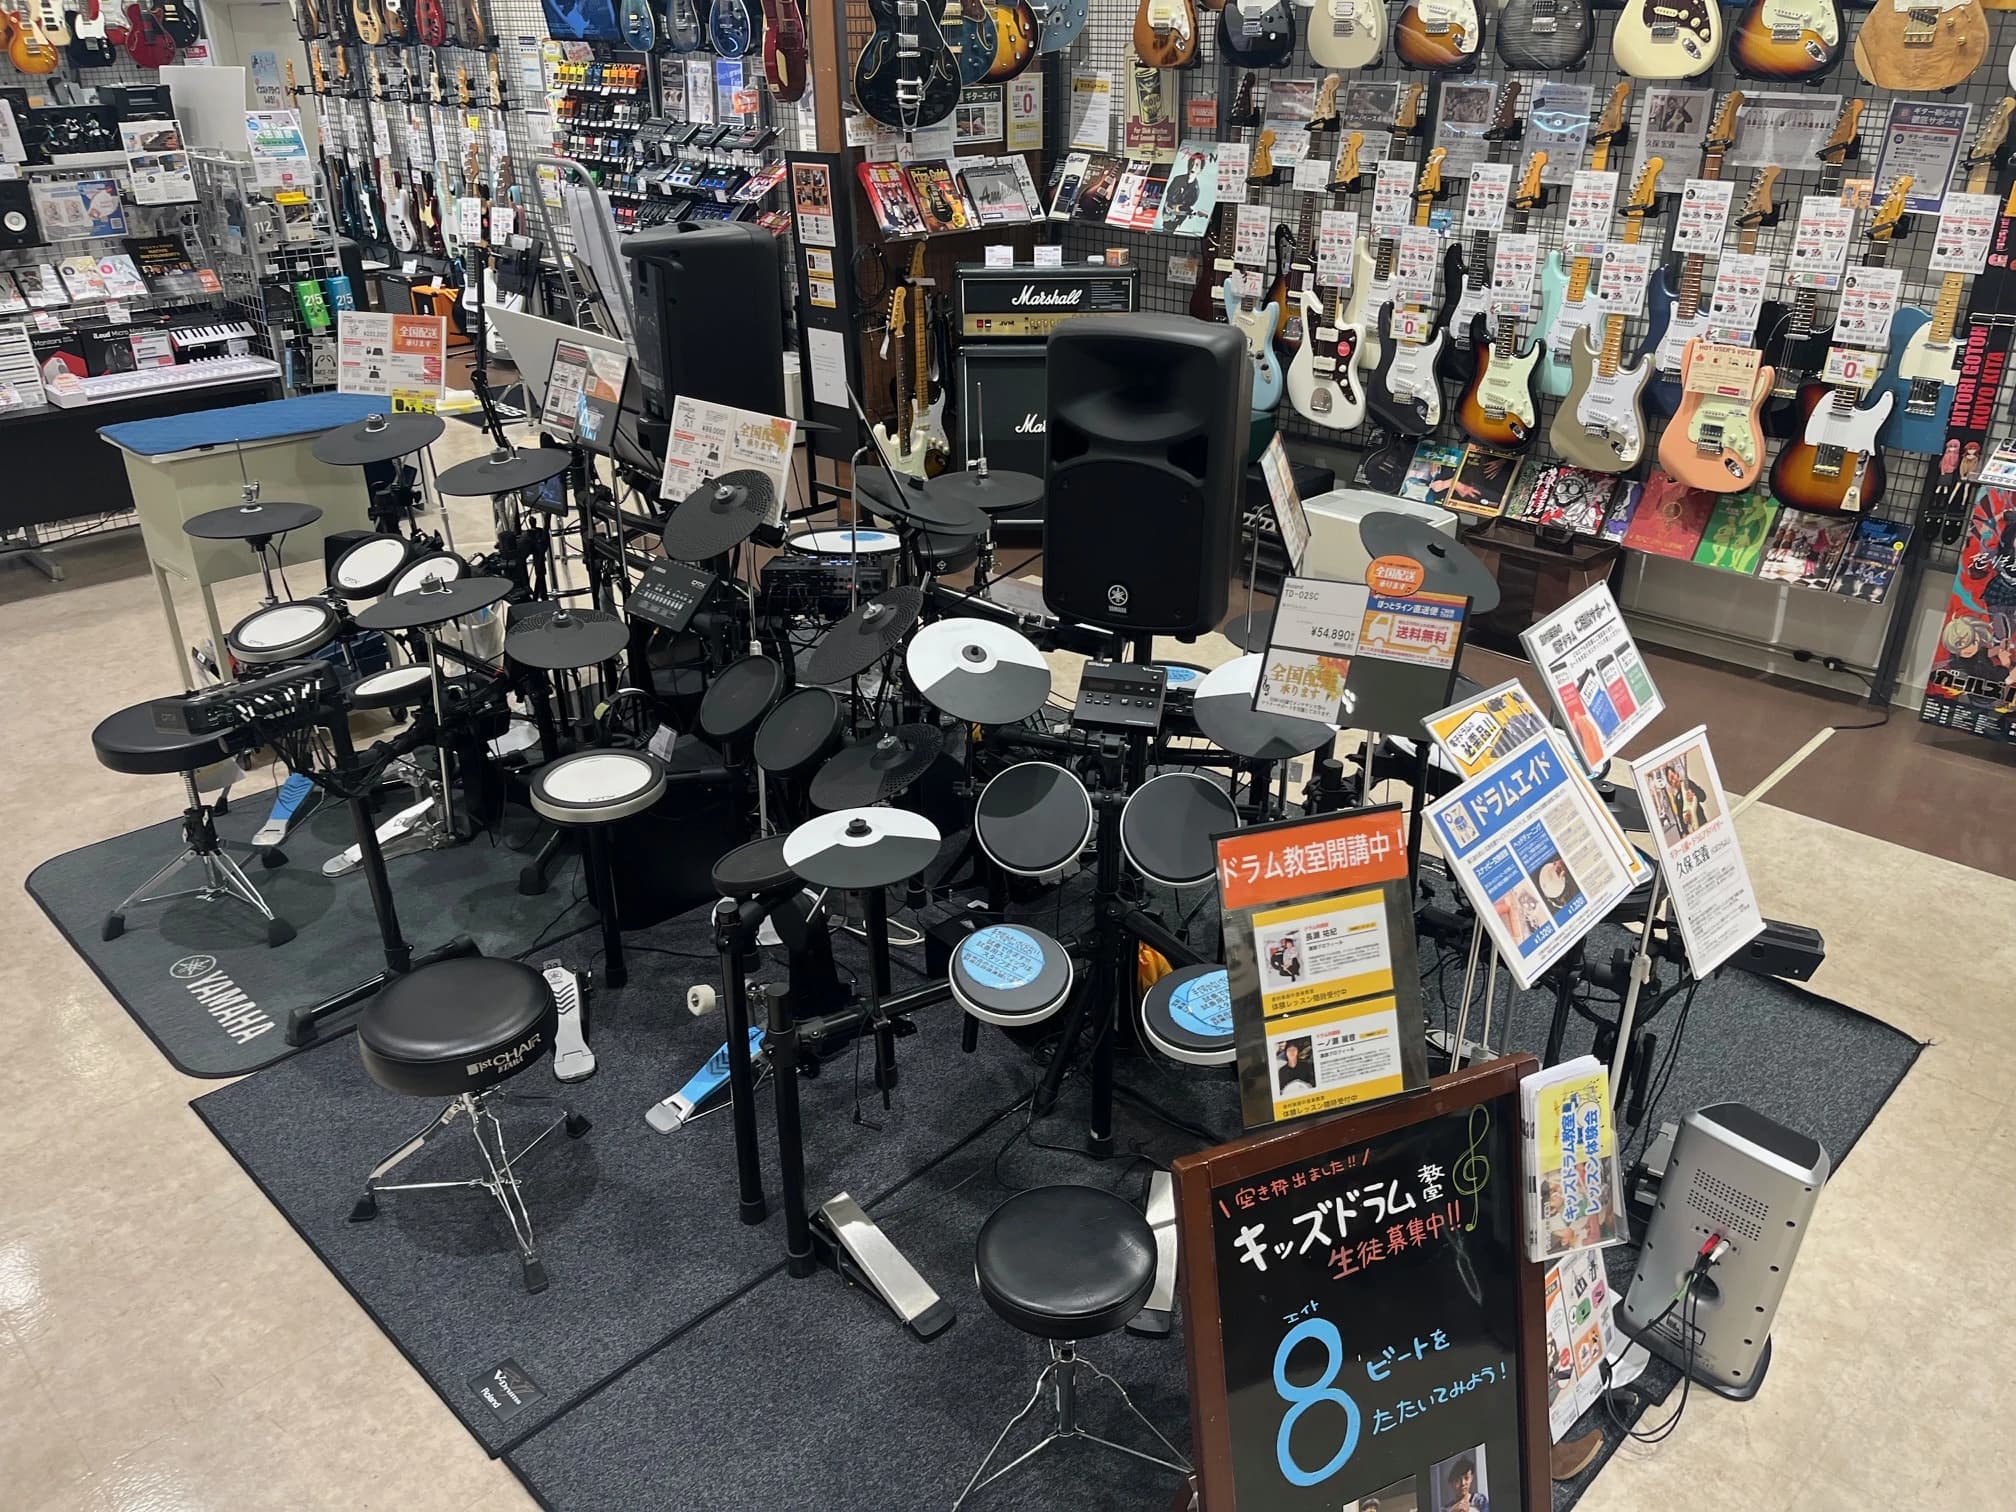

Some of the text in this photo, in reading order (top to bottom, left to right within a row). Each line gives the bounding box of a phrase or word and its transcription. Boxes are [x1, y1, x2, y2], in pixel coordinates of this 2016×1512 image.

[255, 222, 273, 233] 112
[304, 293, 323, 306] 215
[335, 295, 354, 306] 215
[1012, 284, 1083, 306] Marshall
[33, 336, 63, 347] Monitors
[1713, 345, 1736, 355] USER'S
[1736, 347, 1756, 356] VOICE
[1844, 362, 1857, 379] 0
[1951, 326, 1989, 427] HITORI GOTOH
[1969, 351, 2005, 430] IKUYO KITA
[739, 422, 789, 452] 全国配
[1375, 566, 1417, 582] 全国配送
[1285, 589, 1320, 601] TD-02SC
[1377, 600, 1439, 616] ほっとライン直送便
[1311, 626, 1351, 641] ¥54,890
[1396, 626, 1448, 646] 送料無料
[1269, 662, 1334, 692] 全国配
[1280, 684, 1320, 699] 承ります
[1470, 750, 1551, 826] ドラムエイド
[1221, 827, 1407, 889] ドラム教室開講中！
[186, 968, 275, 1045] YAMAHA
[1561, 1107, 1578, 1223] キッズドラム教室
[1584, 1108, 1601, 1214] レッスン体験会
[1233, 1163, 1446, 1272] キッズドラム 教室
[1327, 1199, 1463, 1281] 生徒募集中!!
[1283, 1299, 1320, 1325] エイト
[1365, 1328, 1451, 1383] ビートを
[480, 1386, 502, 1409] Roland
[494, 1368, 522, 1405] V-Drums
[1371, 1360, 1508, 1436] たたいてみよう!
[1272, 1317, 1361, 1487] 8
